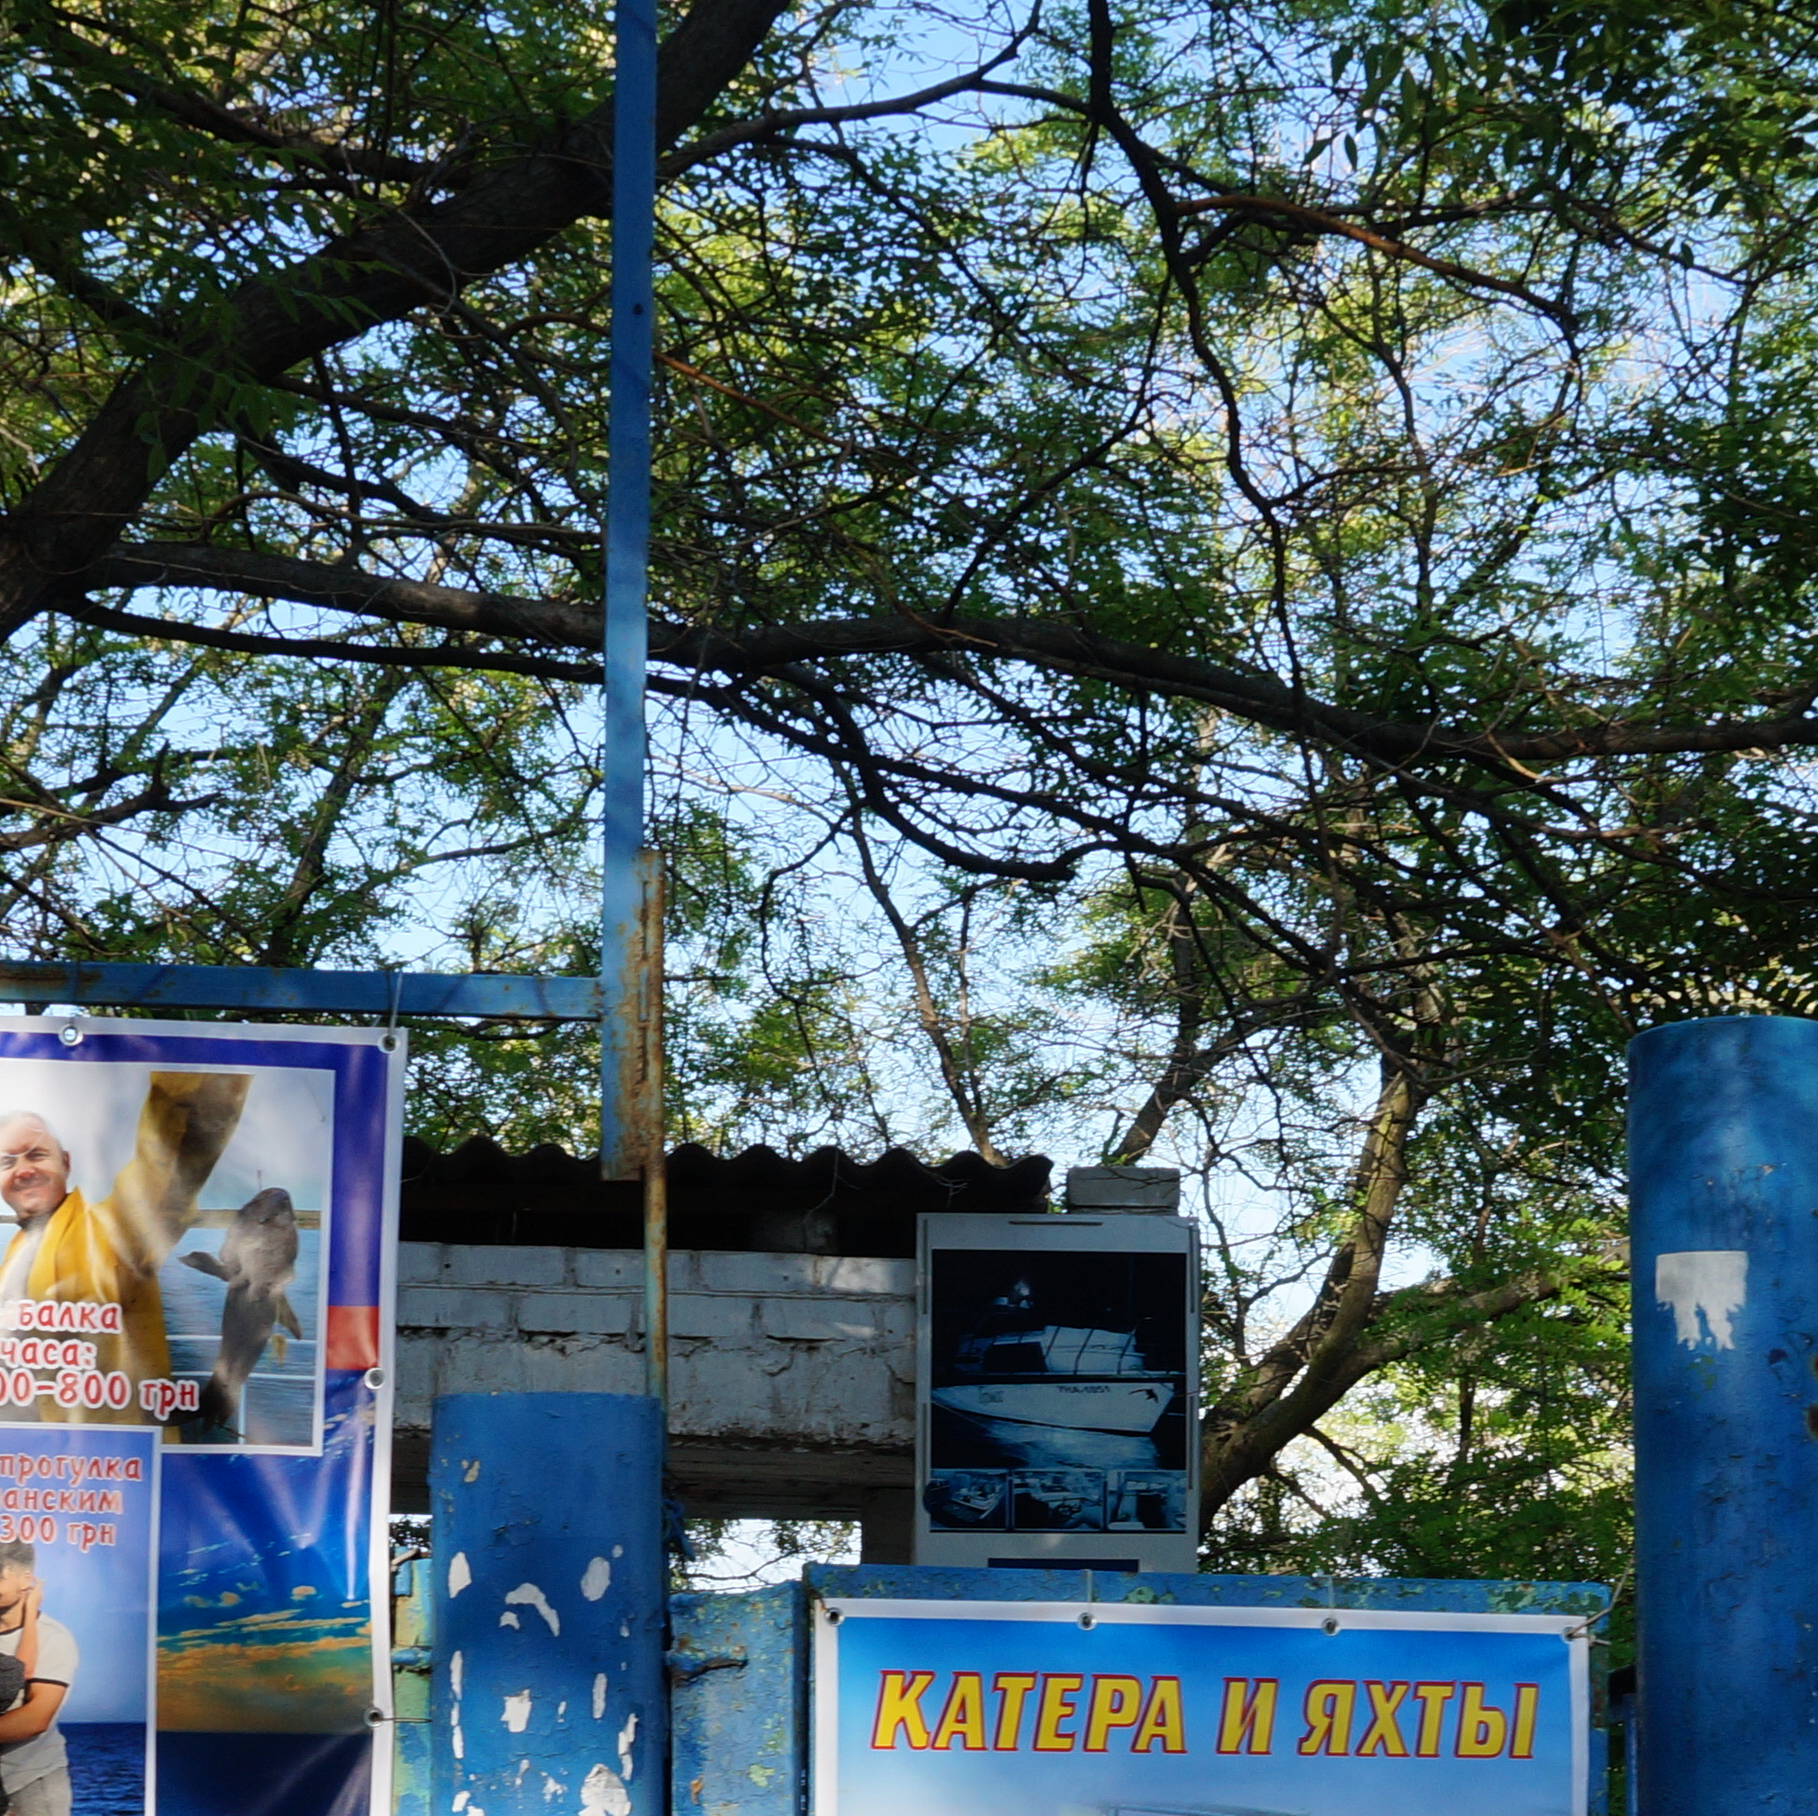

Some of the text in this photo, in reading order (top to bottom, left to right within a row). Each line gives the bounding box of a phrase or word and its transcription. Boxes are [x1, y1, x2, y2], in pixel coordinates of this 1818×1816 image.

[0, 1339, 95, 1368] часа:
[140, 1380, 197, 1418] грн
[67, 1519, 115, 1552] грн
[870, 1668, 1539, 1760] КАТЕРА И ЯХТЫ
